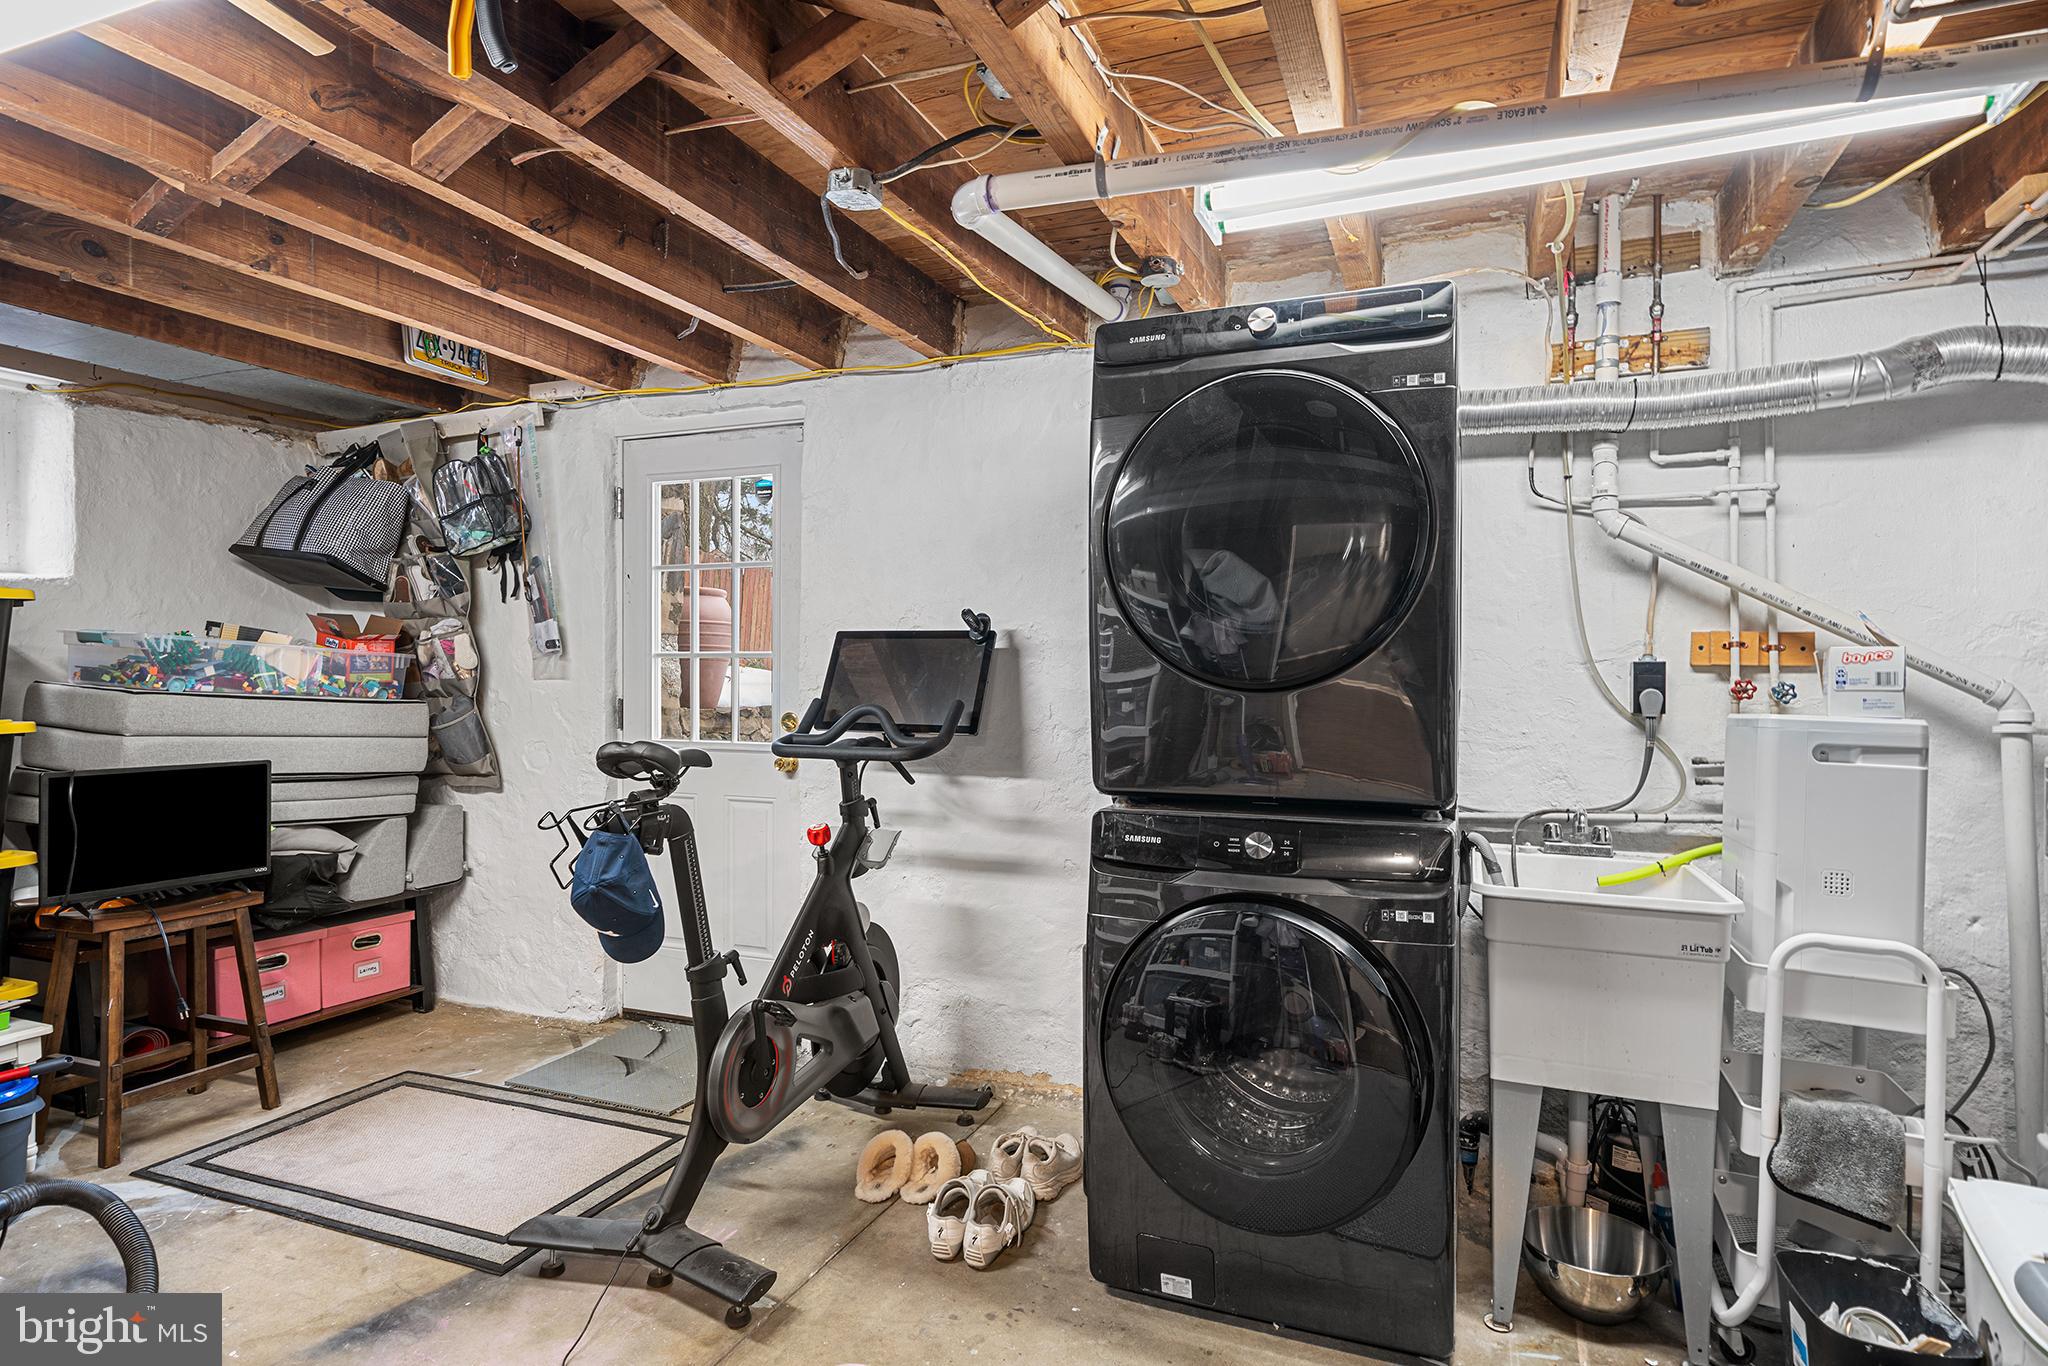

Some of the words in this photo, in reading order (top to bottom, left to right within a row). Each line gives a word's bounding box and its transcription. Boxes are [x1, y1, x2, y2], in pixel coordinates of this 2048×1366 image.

[1497, 107, 1526, 120] EAGLE
[1526, 105, 1541, 117] JM
[1275, 140, 1291, 150] NSF
[1129, 333, 1166, 344] SAMSUNG
[1842, 650, 1894, 665] bounce
[1124, 834, 1162, 844] SAMSUNG
[789, 929, 814, 978] PELOTON
